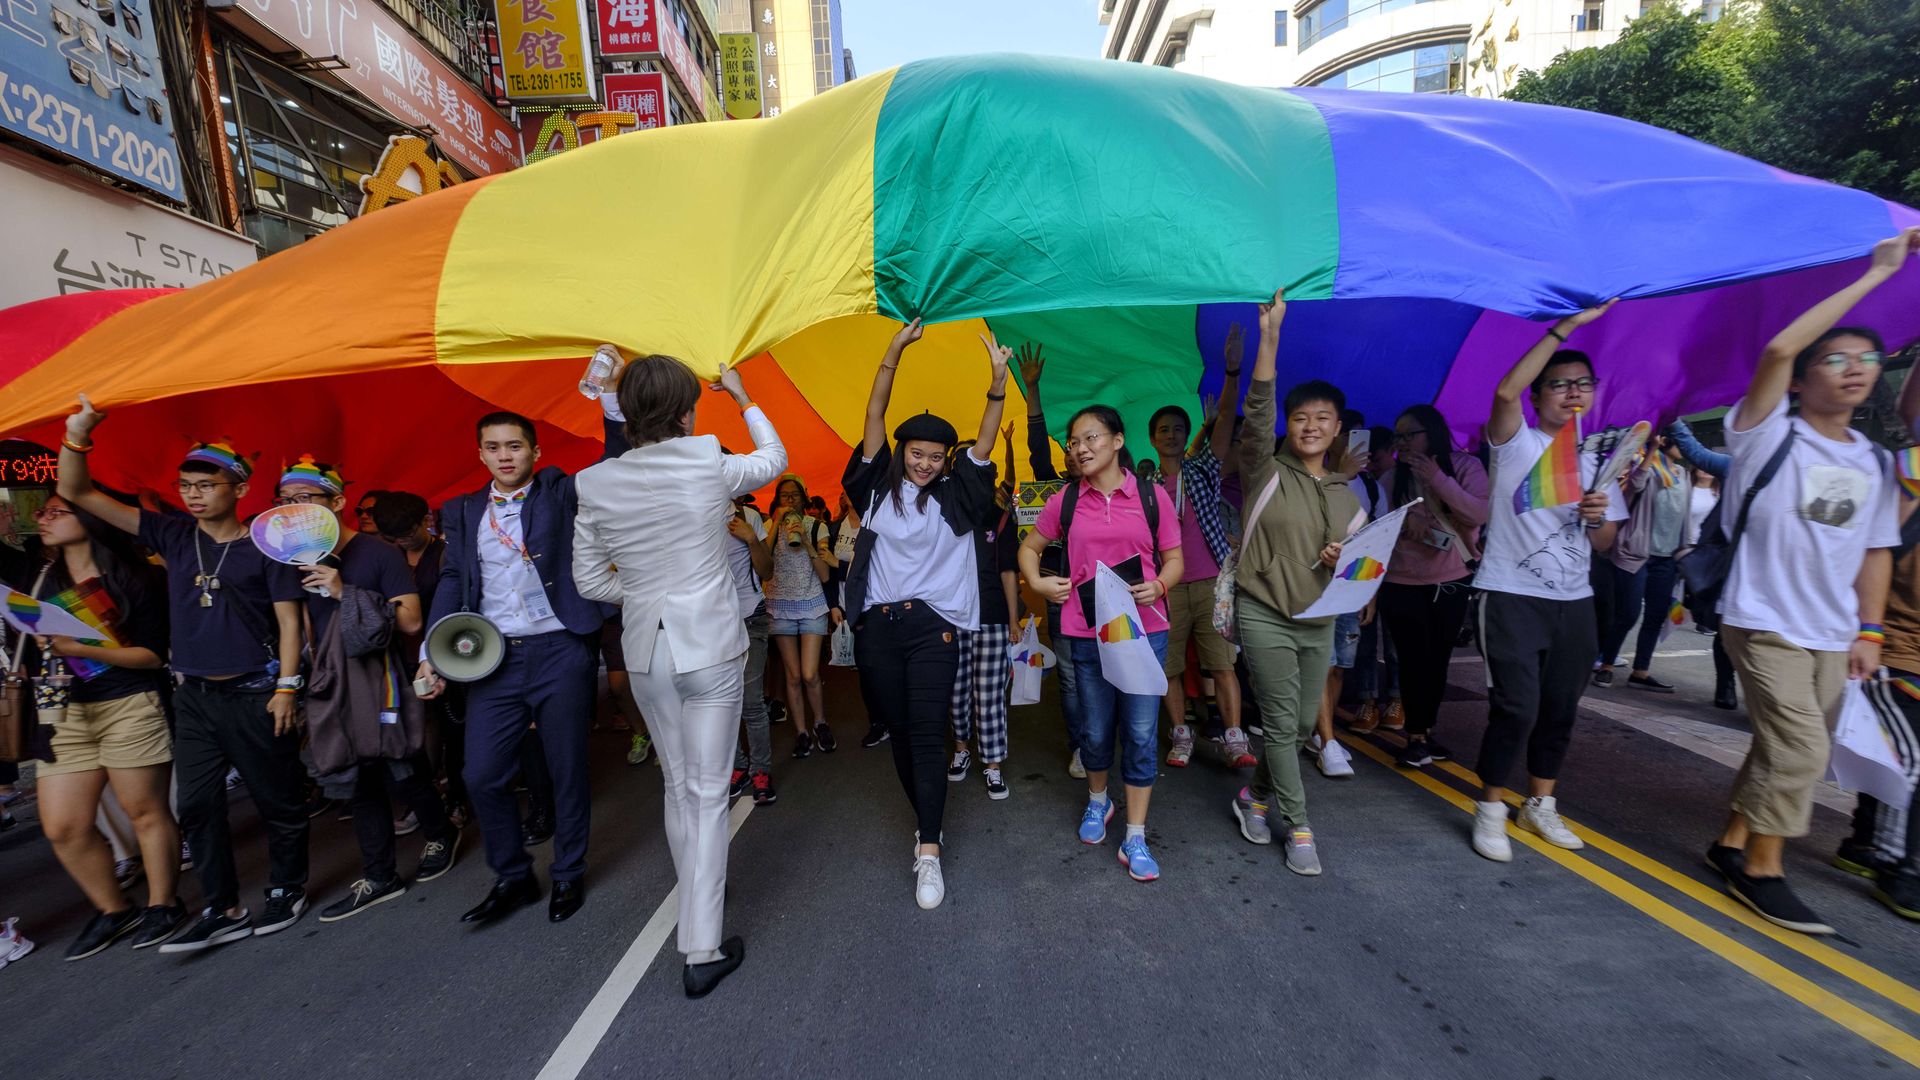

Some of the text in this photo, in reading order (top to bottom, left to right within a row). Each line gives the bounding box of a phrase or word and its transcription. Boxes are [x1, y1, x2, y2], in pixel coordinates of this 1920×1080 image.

[604, 0, 650, 28] 海
[372, 20, 488, 153] 國際髮型
[509, 72, 583, 91] TEL:2361-1755
[724, 45, 742, 102] 證照專家
[741, 45, 758, 101] 公職權威
[382, 85, 448, 141] INTERNATIONAL
[449, 135, 467, 156] HAIR
[468, 150, 491, 174] SALON
[126, 231, 146, 257] T
